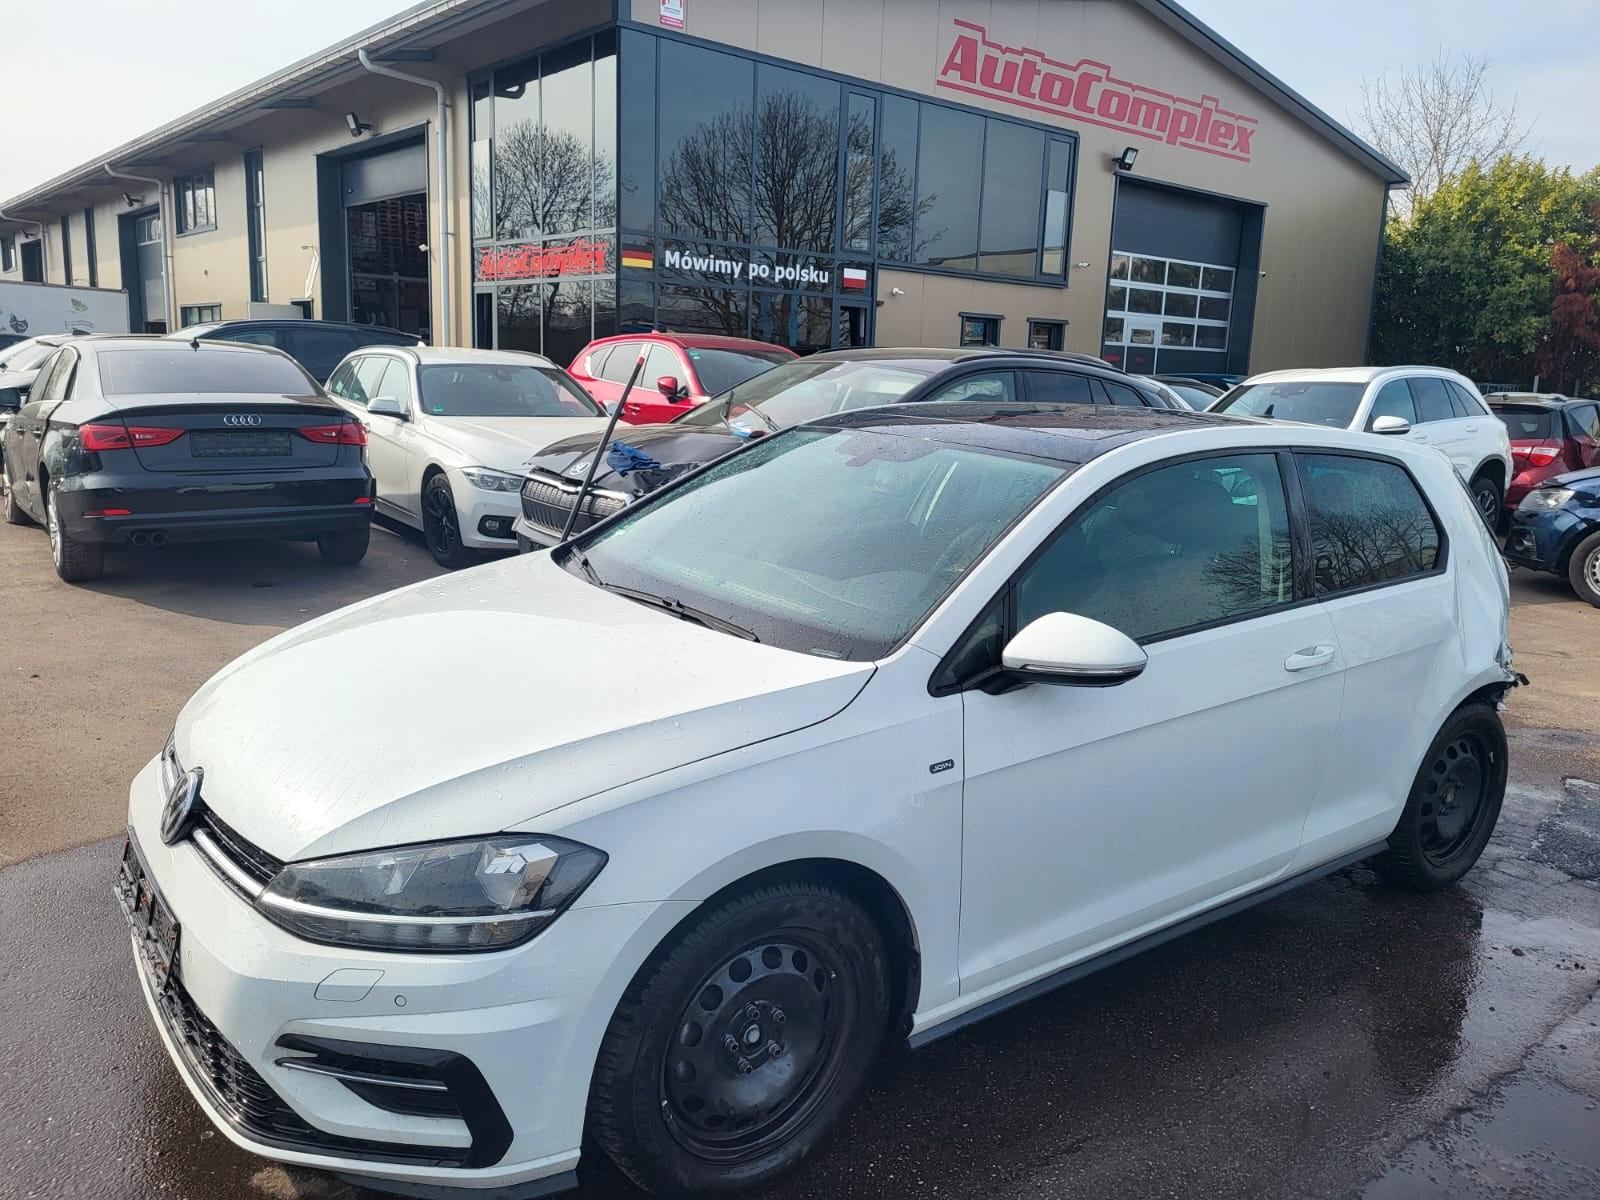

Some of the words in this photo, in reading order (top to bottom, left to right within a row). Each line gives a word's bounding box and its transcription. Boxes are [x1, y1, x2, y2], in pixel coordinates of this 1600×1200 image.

[940, 34, 1256, 155] AutoComplex
[665, 249, 742, 278] Mówimy
[749, 262, 769, 280] po
[775, 264, 829, 283] polsku
[931, 761, 952, 772] JOIN
